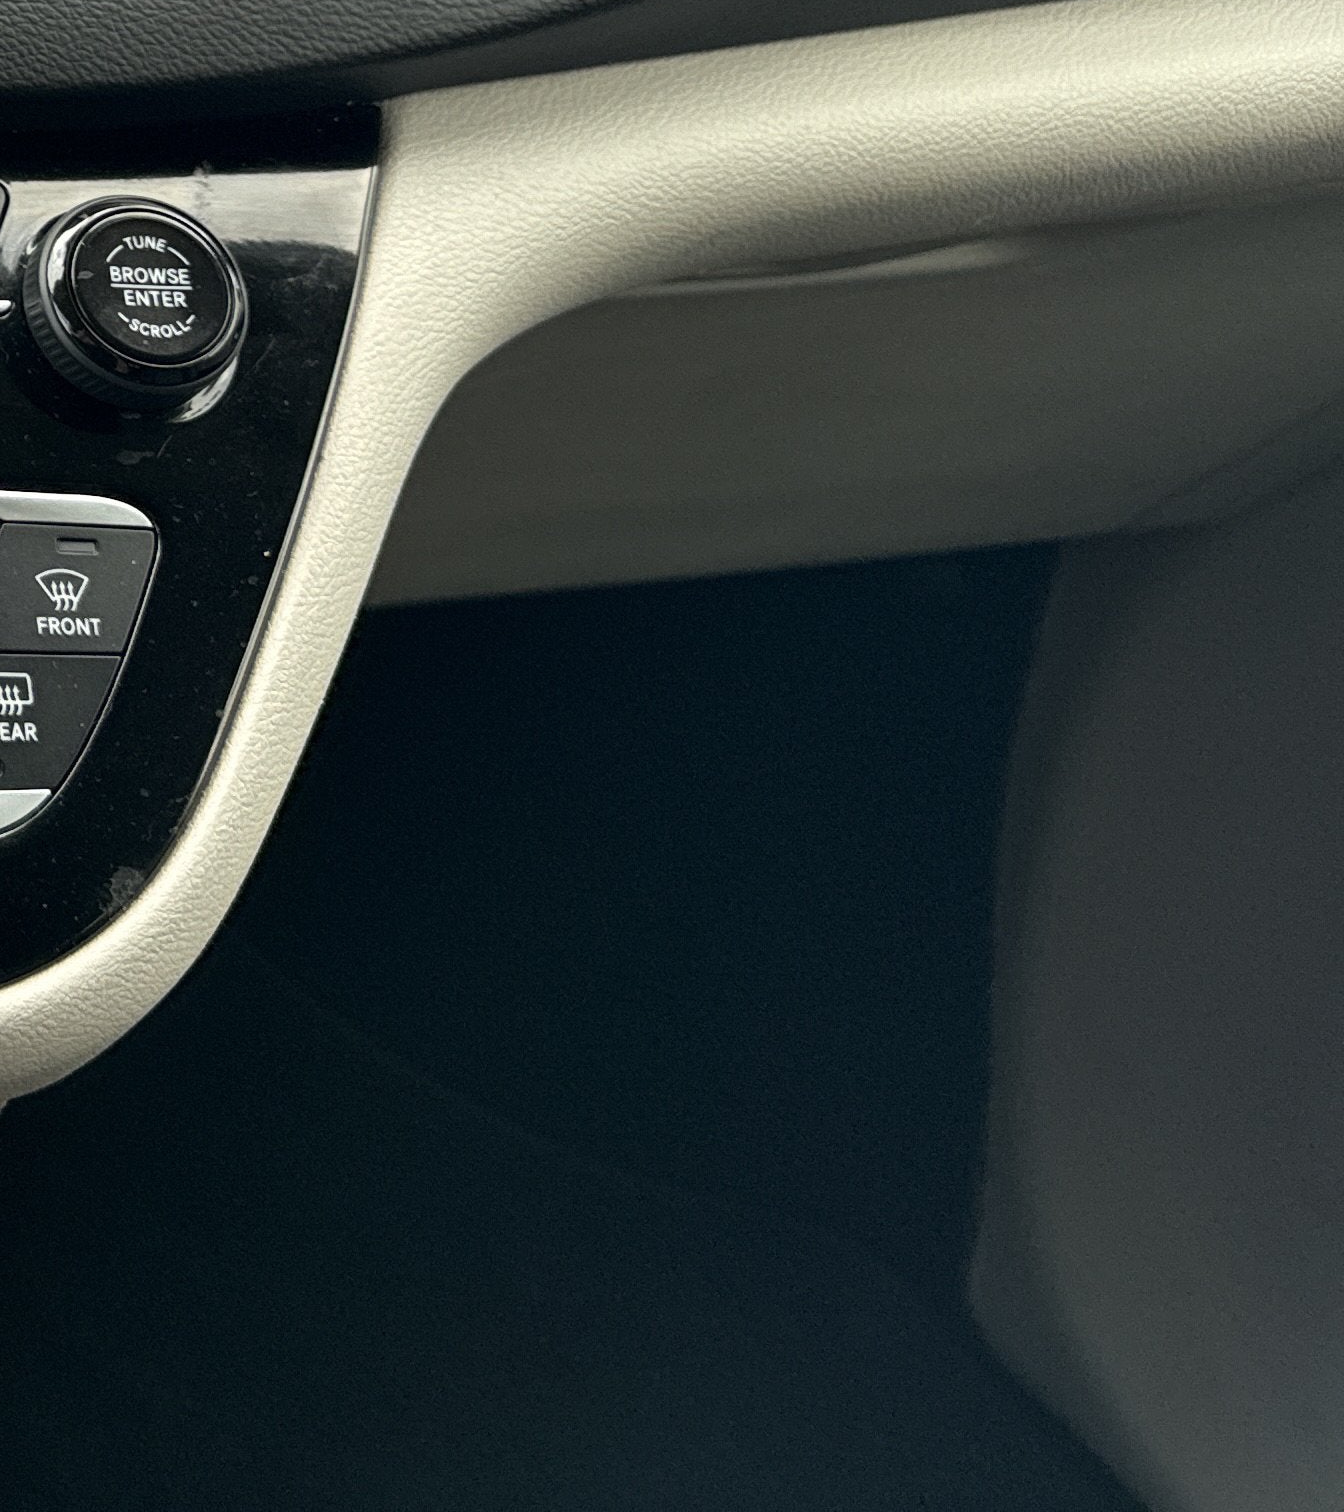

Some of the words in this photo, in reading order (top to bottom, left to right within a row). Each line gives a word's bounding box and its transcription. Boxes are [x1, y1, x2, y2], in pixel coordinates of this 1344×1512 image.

[122, 236, 168, 254] TUNE
[110, 265, 191, 285] BROWSE
[124, 290, 188, 308] ENTER
[128, 317, 190, 339] SCROLL
[35, 616, 102, 638] FRONT
